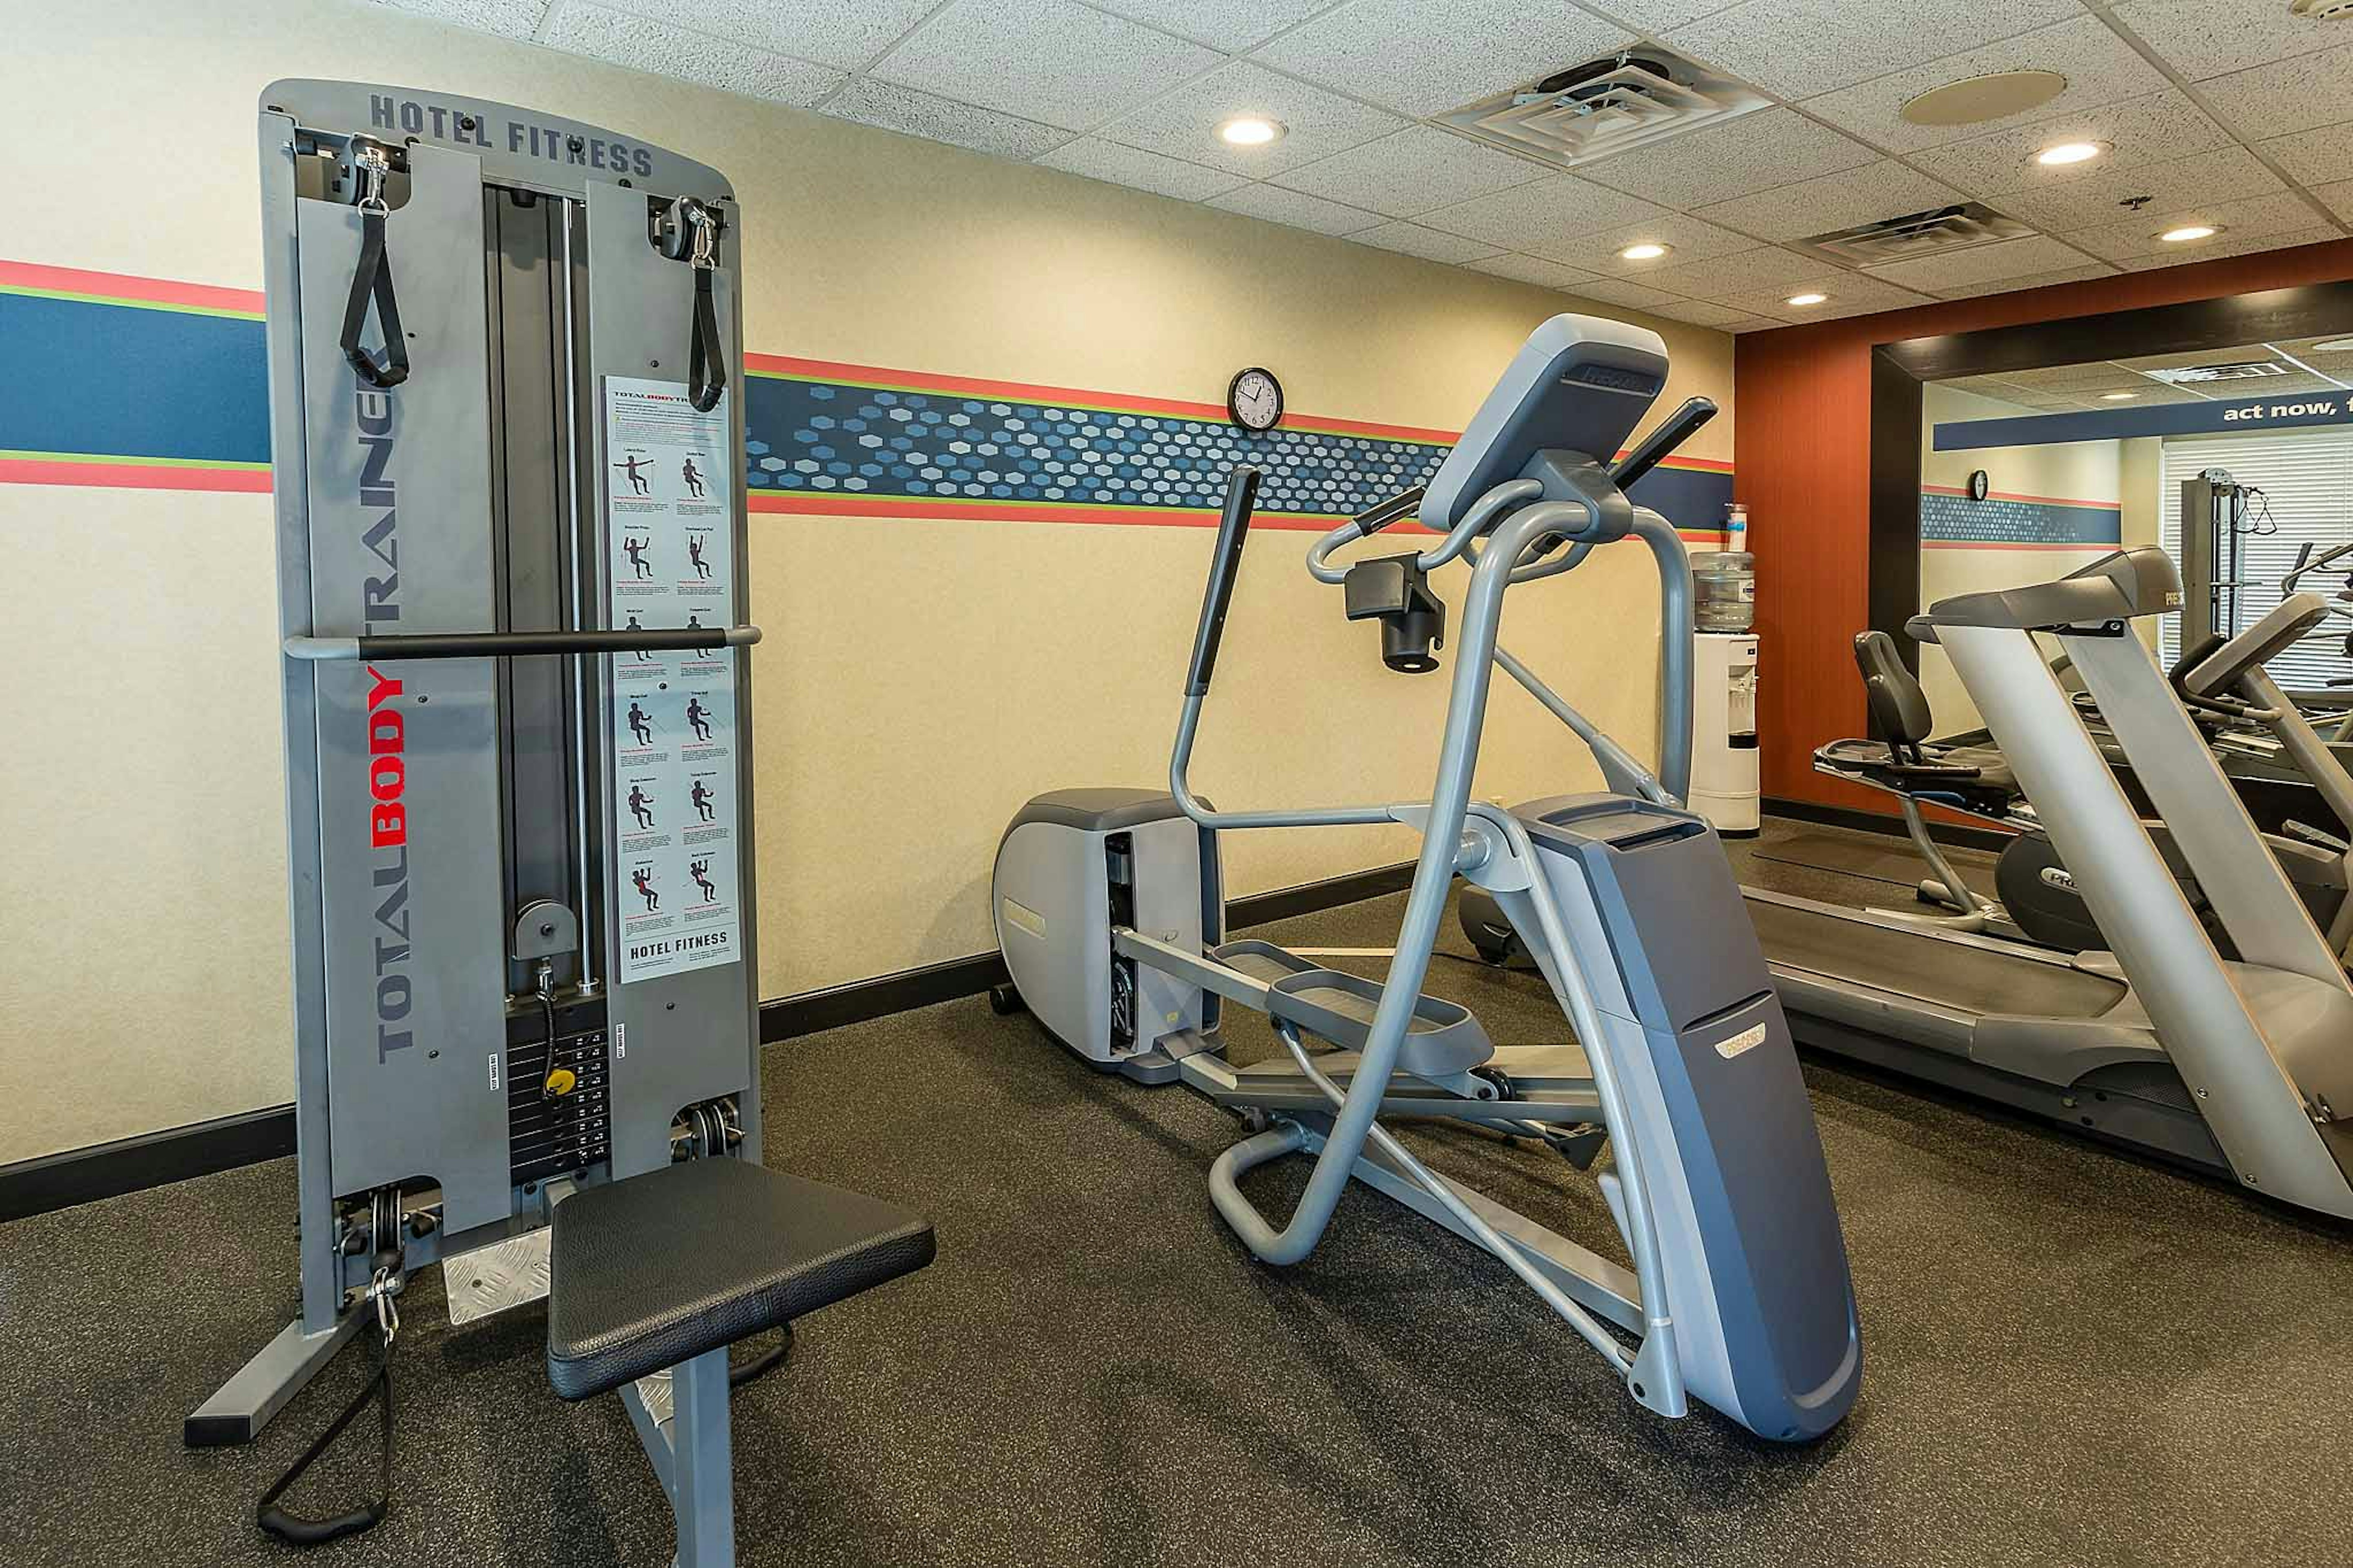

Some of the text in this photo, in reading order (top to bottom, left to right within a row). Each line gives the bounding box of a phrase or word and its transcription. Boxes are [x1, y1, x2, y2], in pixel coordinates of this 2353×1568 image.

[371, 94, 492, 147] HOTEL
[2224, 405, 2264, 421] act
[2270, 402, 2337, 417] now,
[631, 941, 671, 959] HOTEL
[676, 932, 727, 951] FITNESS
